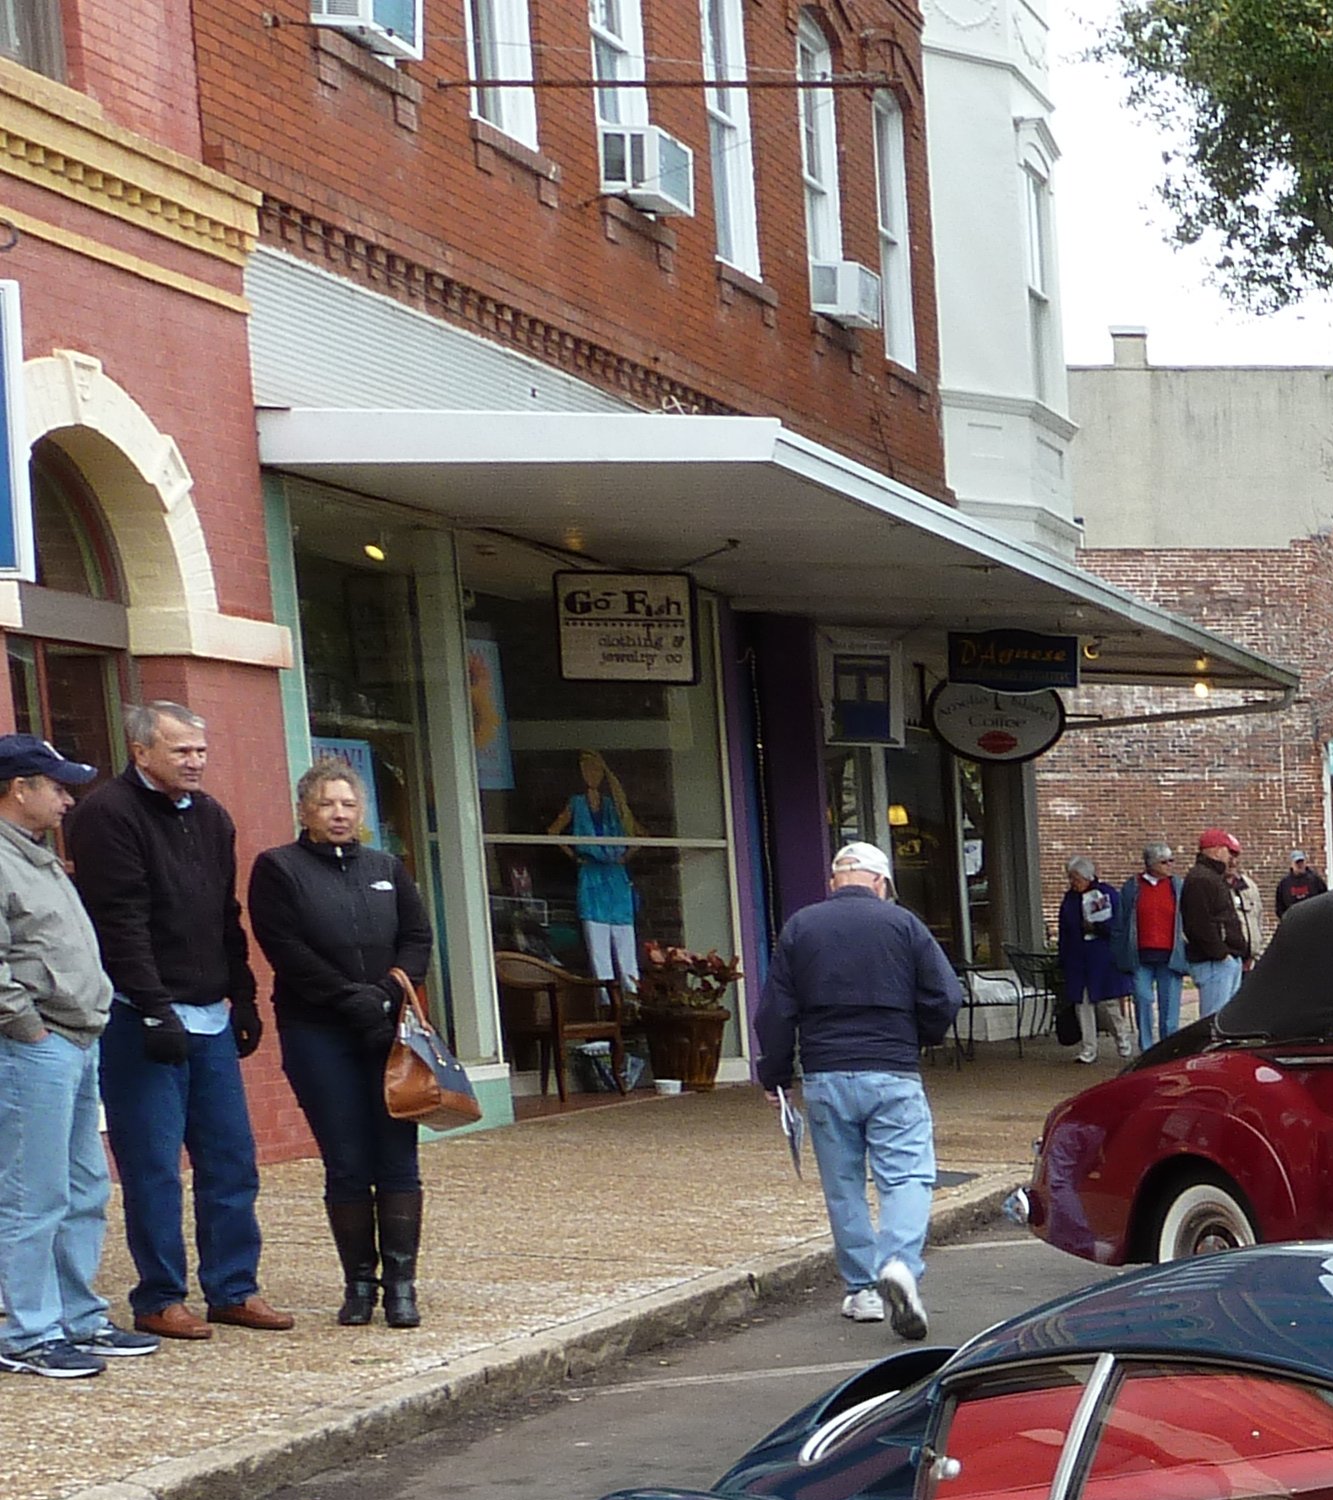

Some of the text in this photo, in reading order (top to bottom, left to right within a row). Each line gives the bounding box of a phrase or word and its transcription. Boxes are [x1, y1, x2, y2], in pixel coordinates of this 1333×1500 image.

[622, 590, 682, 617] Fish
[599, 635, 663, 652] clothing
[968, 715, 1028, 728] Coffee
